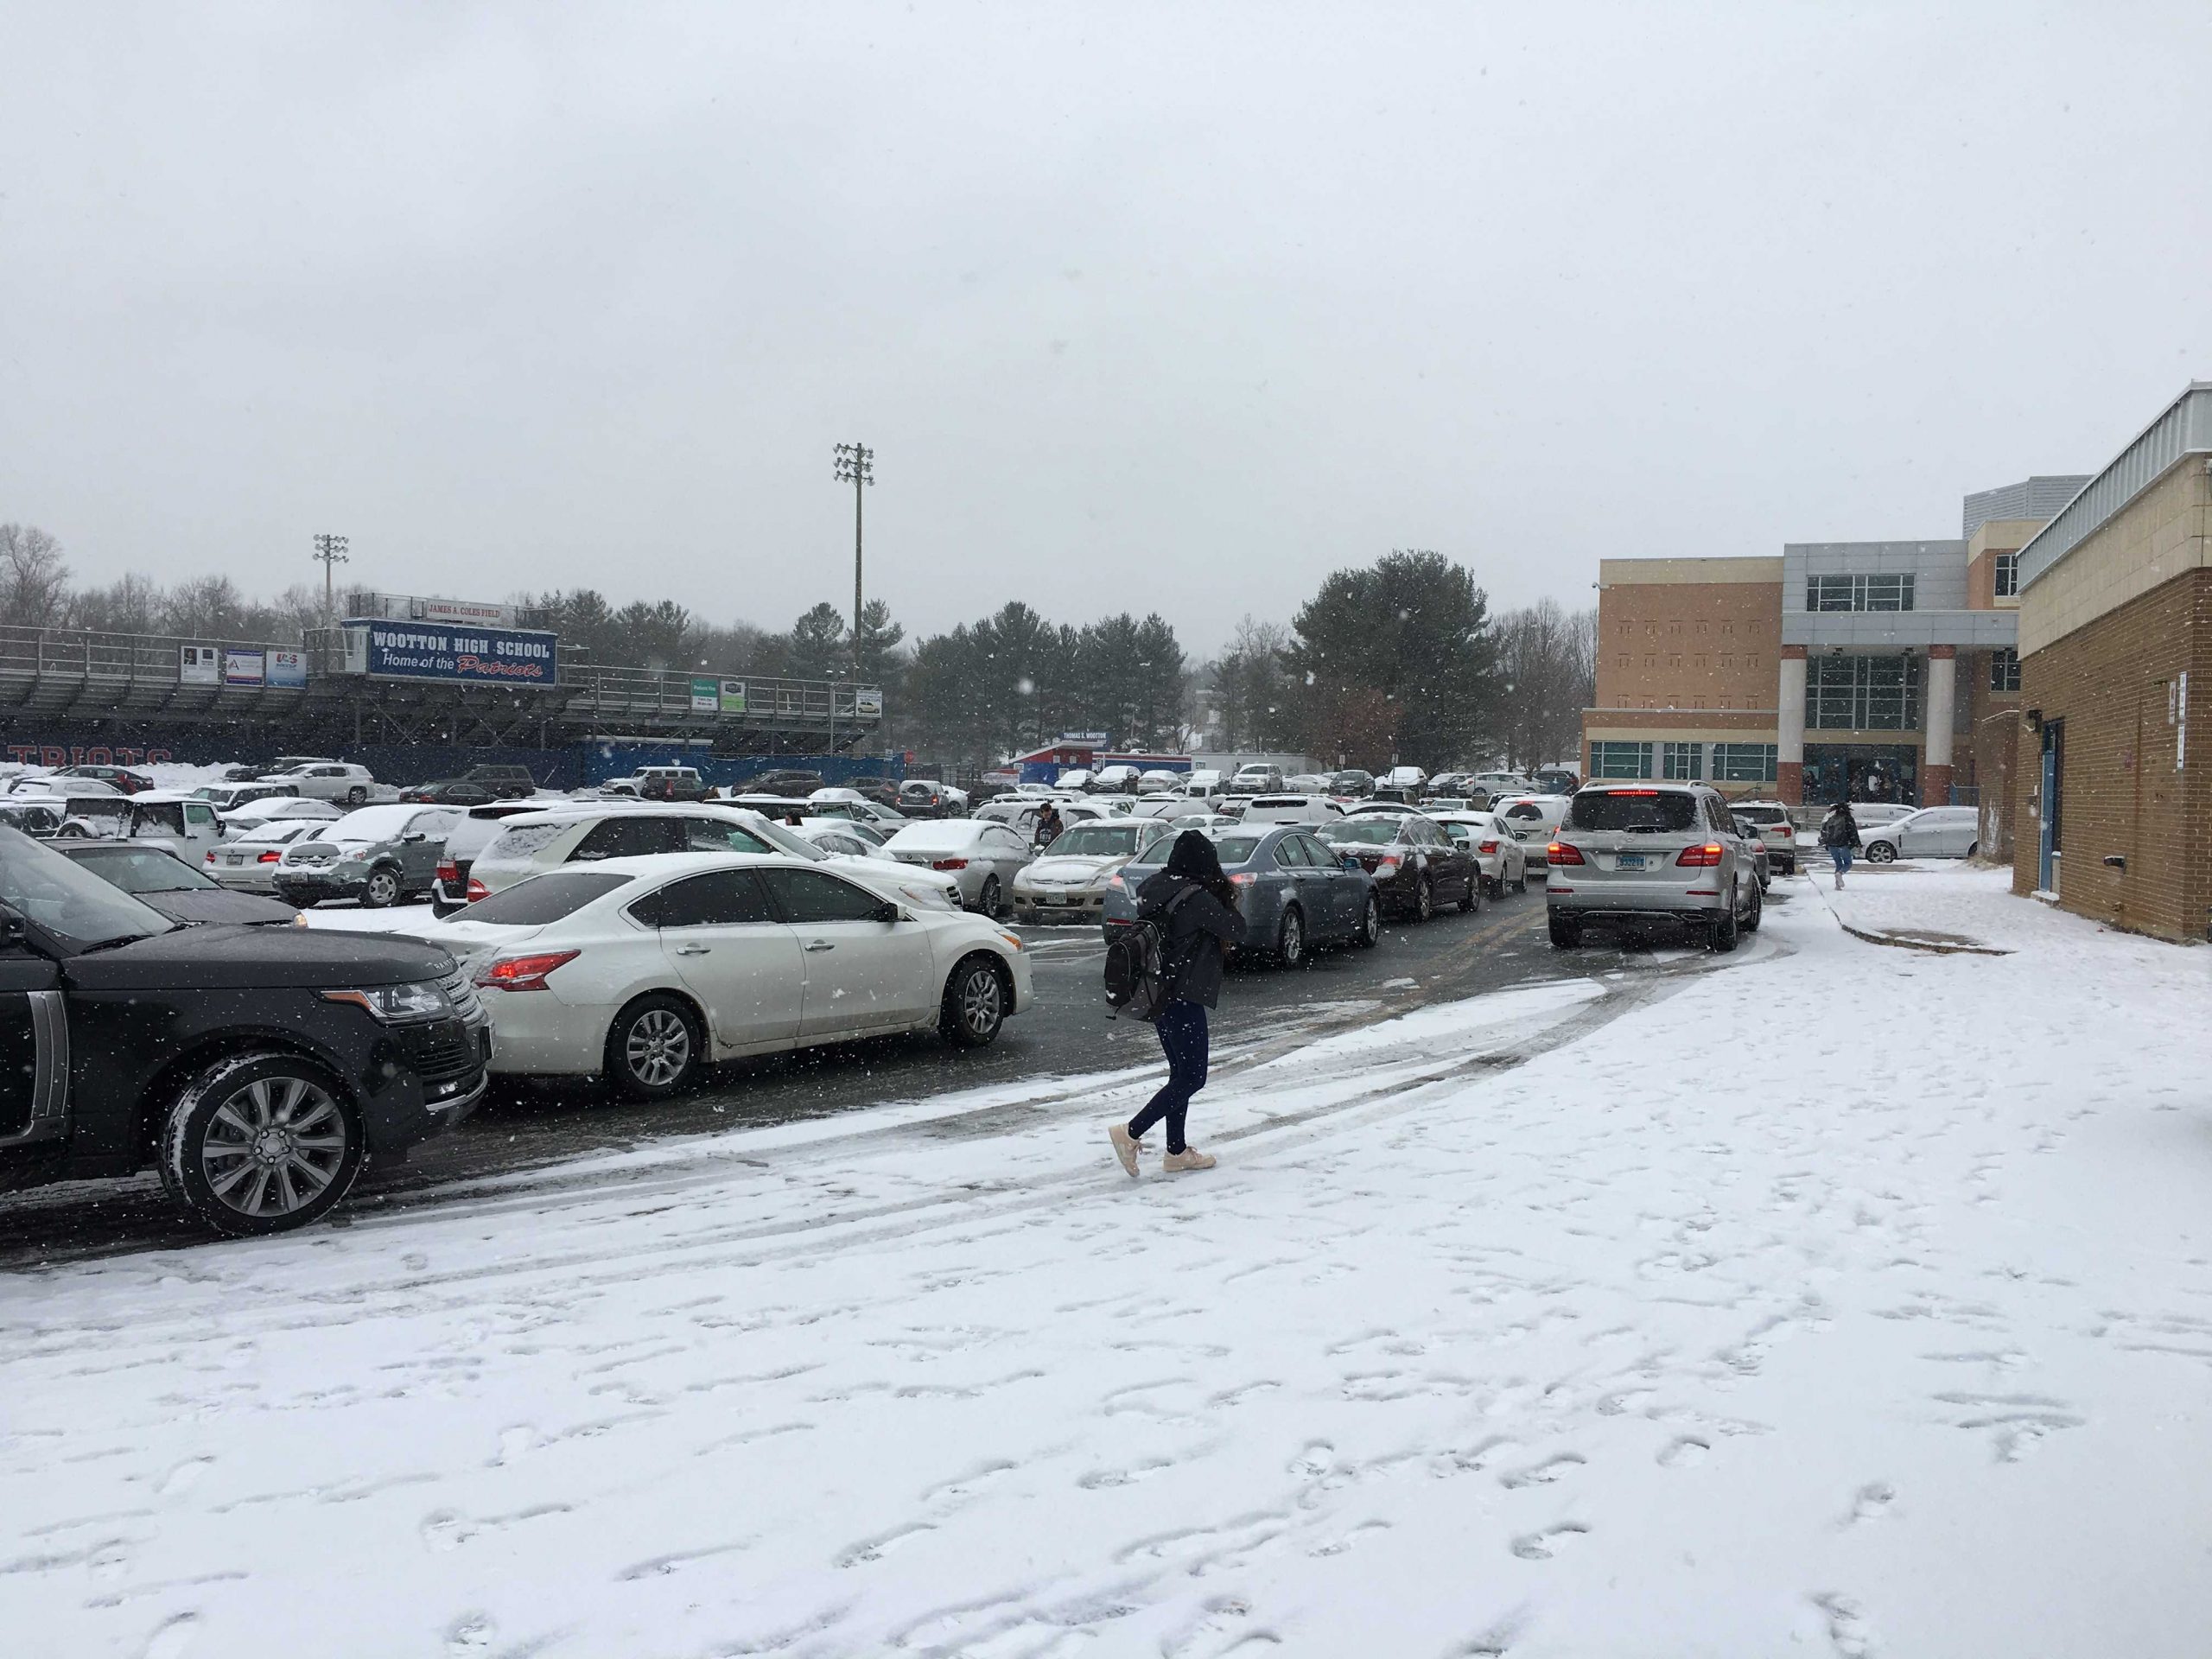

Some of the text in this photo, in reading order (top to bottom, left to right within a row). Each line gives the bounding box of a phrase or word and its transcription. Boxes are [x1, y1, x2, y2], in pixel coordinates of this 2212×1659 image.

[429, 605, 452, 614] JAMES
[460, 608, 480, 617] COLES
[481, 609, 500, 618] FIELD
[373, 632, 550, 658] WOOTTON HIGH SCHOOL
[383, 653, 543, 677] Home of the Patriots
